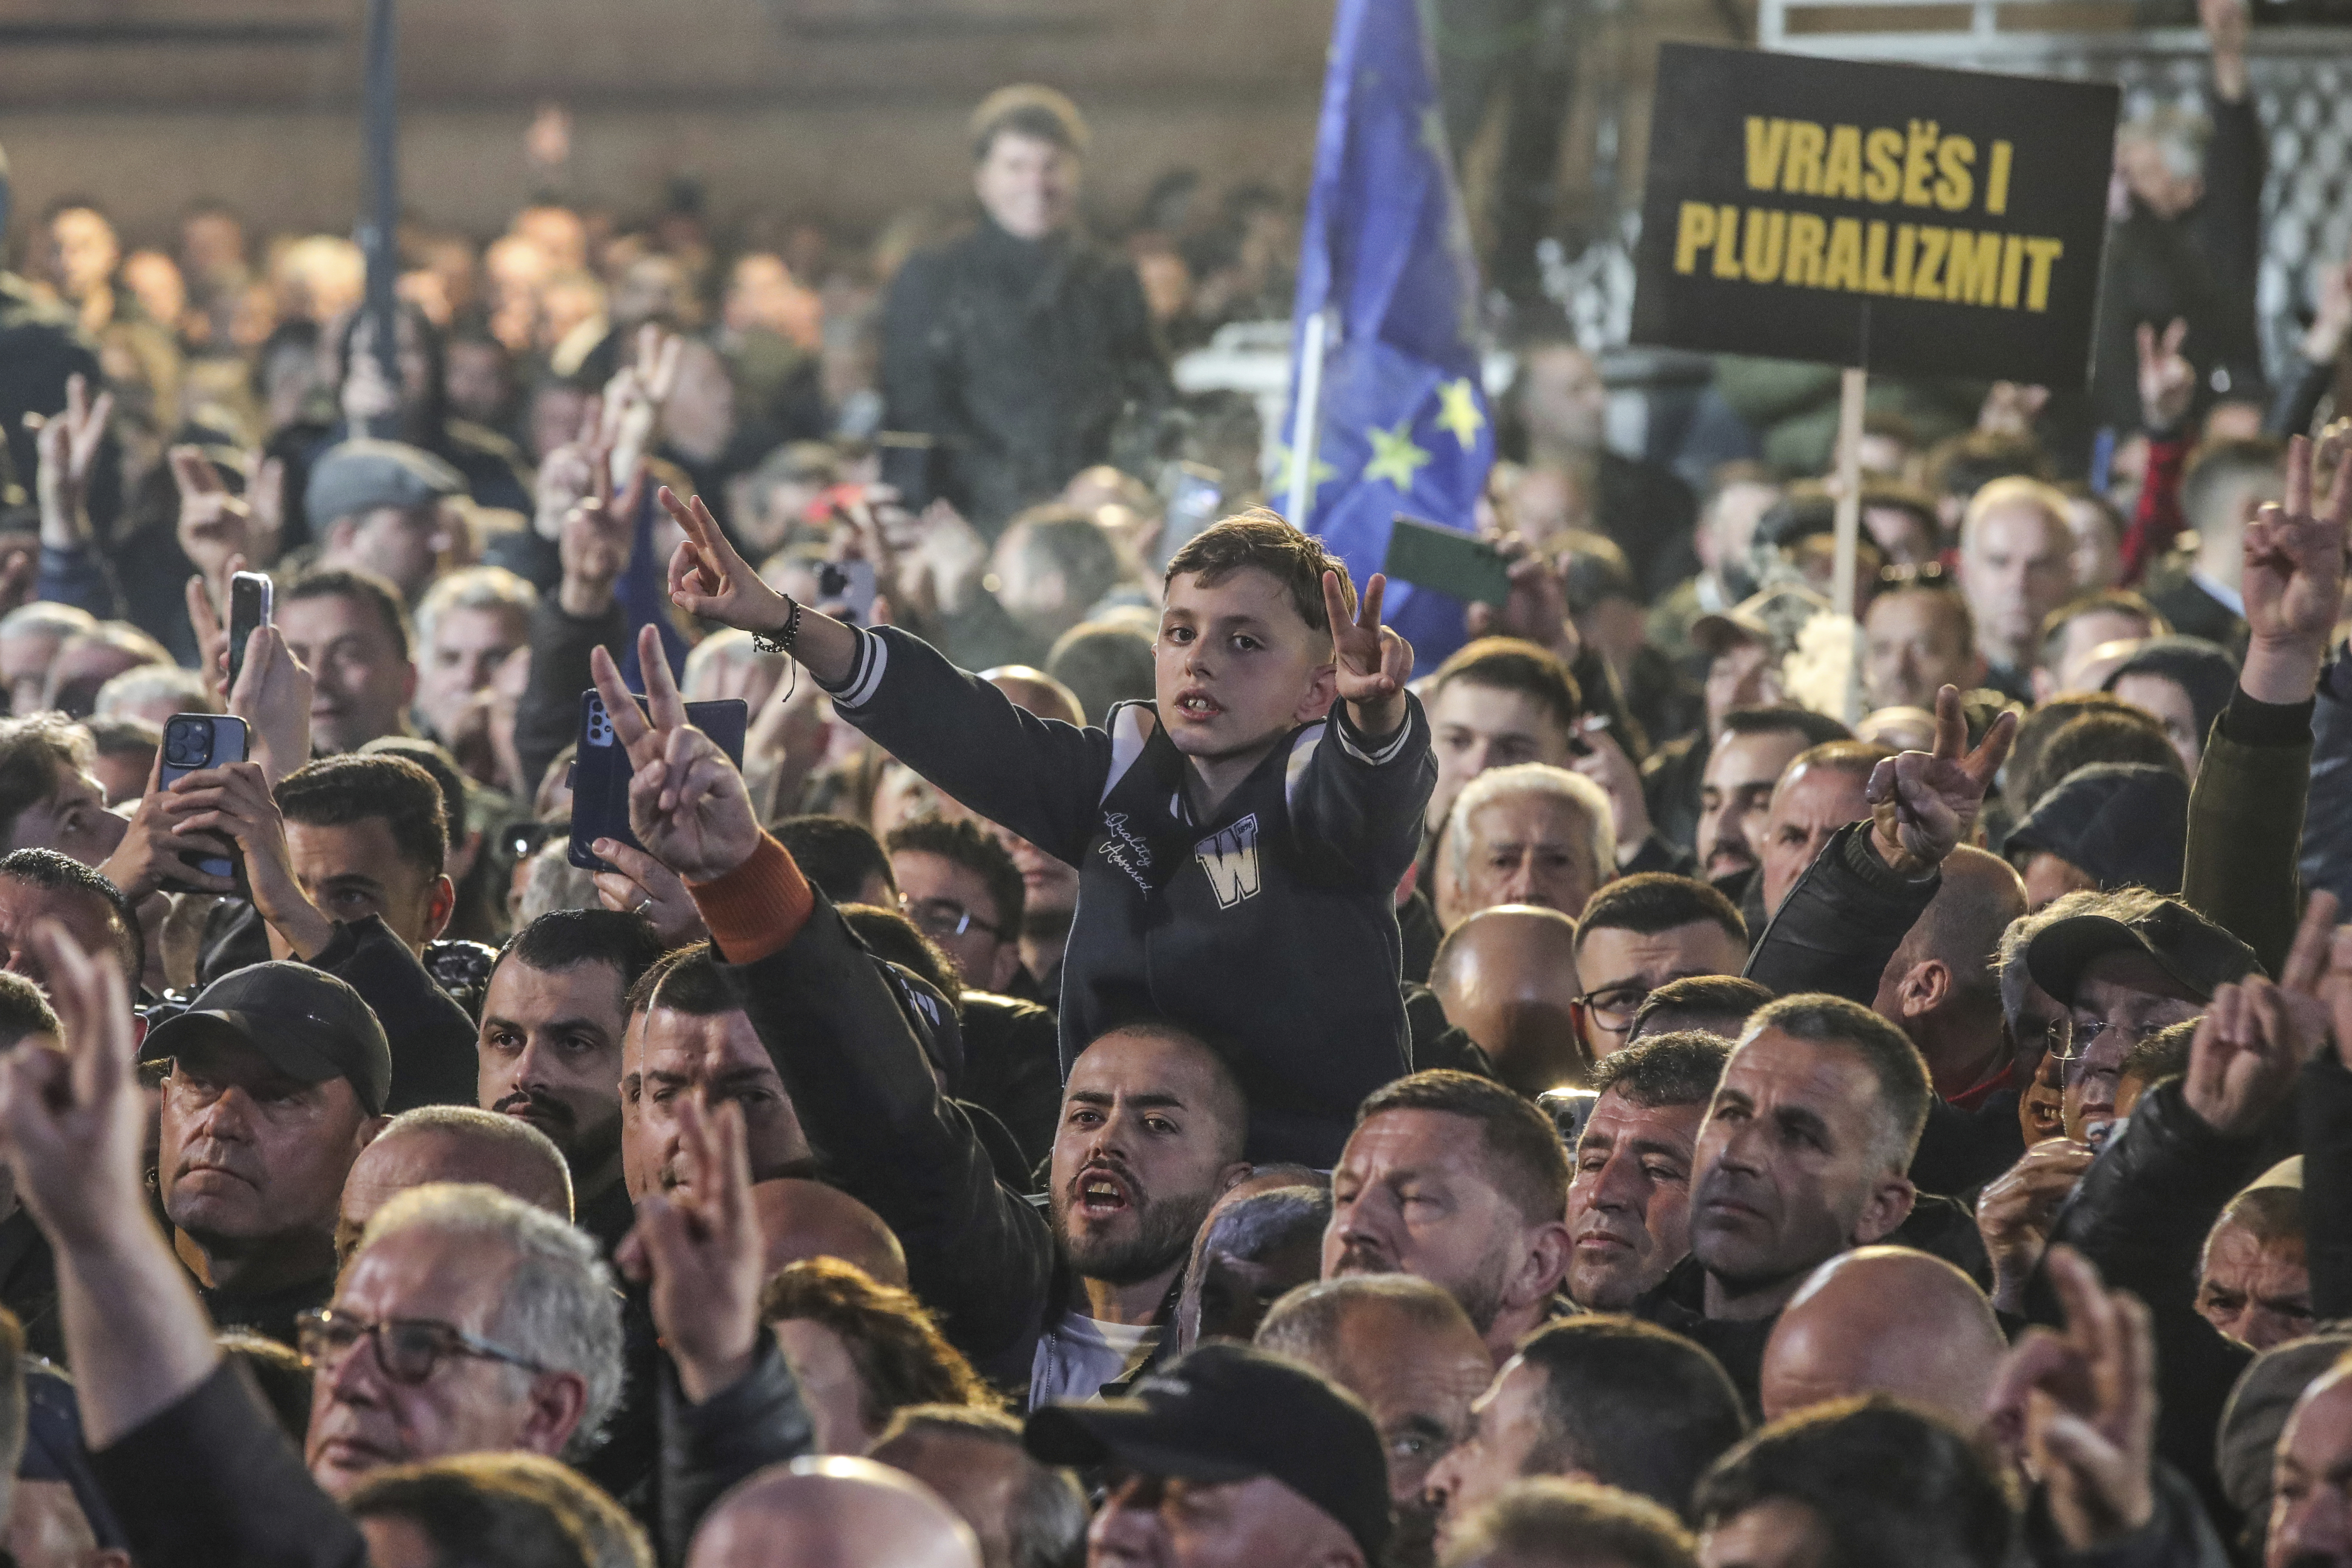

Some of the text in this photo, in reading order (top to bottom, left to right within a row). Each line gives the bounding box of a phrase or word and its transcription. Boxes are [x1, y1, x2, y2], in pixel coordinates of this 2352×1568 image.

[1745, 116, 2013, 214] VRASËS I
[1674, 201, 2063, 312] PLURALIZMIT
[1099, 841, 1152, 901] Assured
[1103, 811, 1152, 867] Quality
[1194, 813, 1260, 910] W
